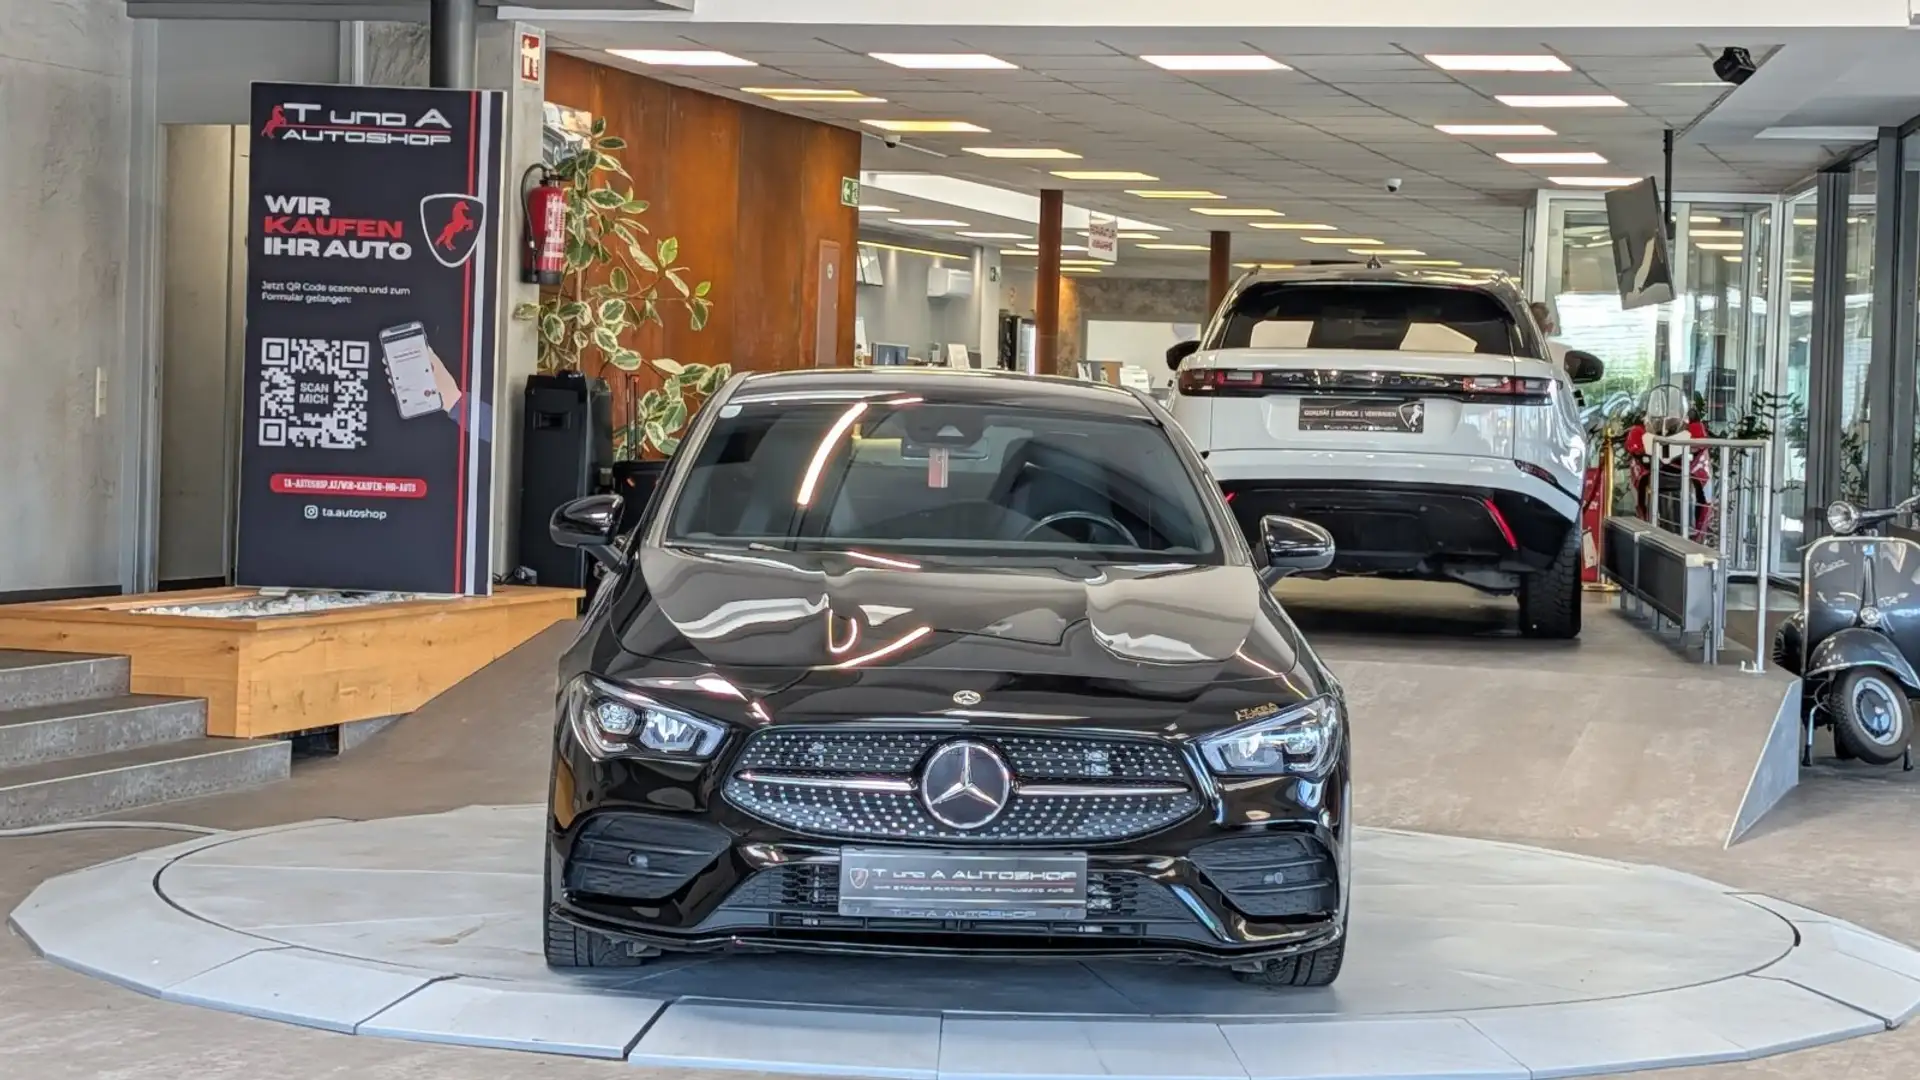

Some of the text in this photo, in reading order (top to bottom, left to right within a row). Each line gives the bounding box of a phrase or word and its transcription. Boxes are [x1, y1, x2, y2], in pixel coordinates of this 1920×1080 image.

[284, 103, 322, 122] T
[414, 108, 452, 128] A
[282, 128, 452, 146] AUTOSHOP
[264, 195, 331, 215] WIR
[264, 216, 403, 238] KAUFEN
[264, 237, 412, 260] IHR AUTO
[261, 281, 411, 296] Jetzt QR Code scannen und zum
[261, 292, 352, 305] Formular gelangen:
[300, 382, 329, 393] SCAN
[299, 394, 329, 404] MICH
[322, 508, 387, 520] ta.autoshop
[872, 868, 887, 877] T
[931, 870, 946, 879] A
[952, 870, 1077, 880] AUTOSHOP
